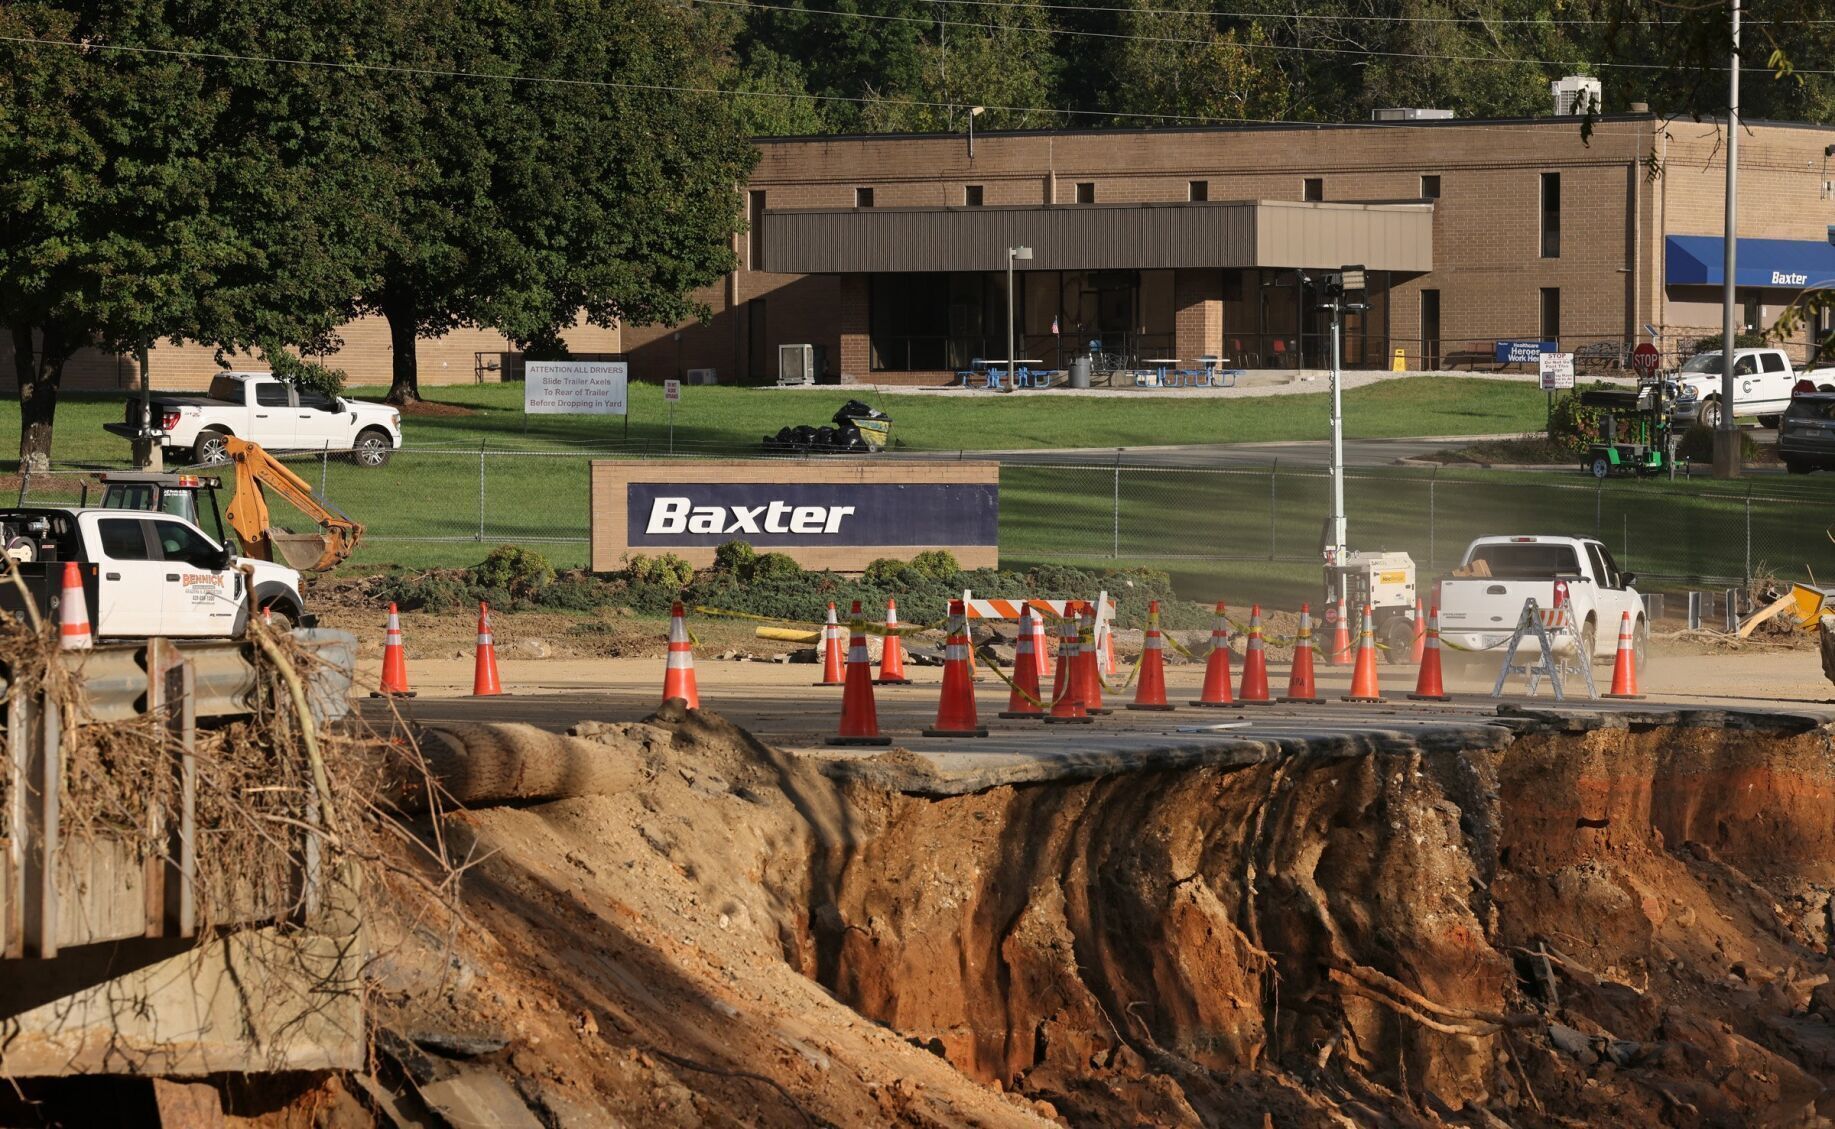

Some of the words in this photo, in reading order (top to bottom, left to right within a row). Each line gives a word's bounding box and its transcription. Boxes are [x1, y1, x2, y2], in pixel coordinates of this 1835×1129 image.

[1771, 271, 1808, 285] Baxter
[1511, 347, 1541, 355] Heroes
[1507, 354, 1526, 362] Work
[1634, 353, 1658, 366] STOP
[530, 366, 572, 374] ATTENTION
[573, 366, 589, 374] ALL
[590, 366, 624, 374] DRIVERS
[542, 377, 562, 385] Slide
[563, 377, 589, 385] Trailer
[589, 377, 611, 385] Axels
[543, 388, 553, 396] To
[555, 388, 574, 396] Rear
[574, 388, 583, 396] of
[583, 388, 609, 396] Trailer
[530, 399, 556, 407] Before
[557, 399, 594, 409] Dropping
[595, 399, 603, 407] in
[604, 399, 622, 408] Yard
[645, 497, 856, 534] Baxter
[183, 573, 225, 588] BENNICK
